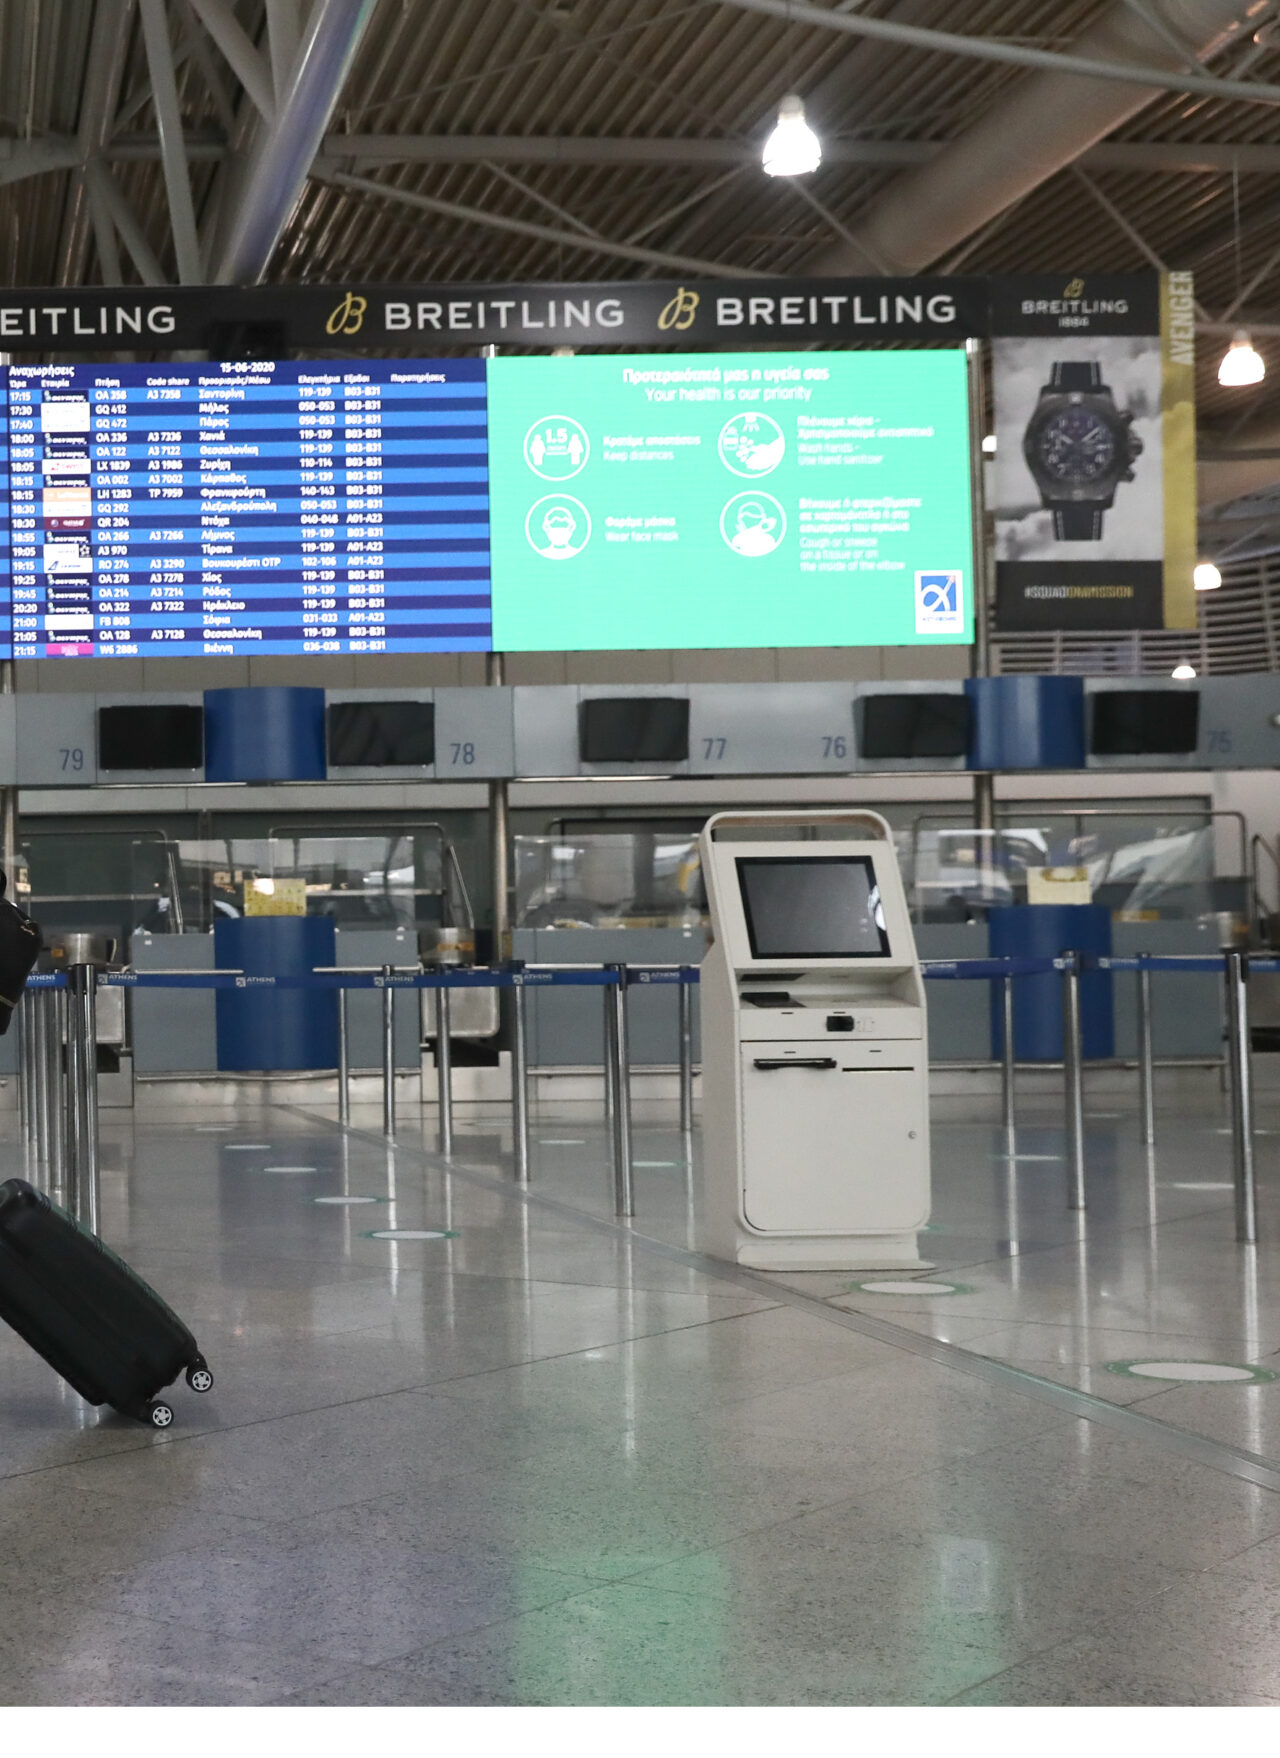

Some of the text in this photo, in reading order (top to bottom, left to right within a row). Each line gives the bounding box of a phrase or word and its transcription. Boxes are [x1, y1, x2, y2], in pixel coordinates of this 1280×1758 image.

[384, 299, 624, 330] BREITLING
[717, 295, 956, 326] BREITLING
[1021, 299, 1128, 314] BREITLING
[1170, 271, 1195, 365] AVENGER
[8, 364, 74, 377] Αναχωρήσεις
[220, 362, 275, 372] 15-06-2020
[10, 392, 31, 401] 17:15
[646, 386, 812, 402] Your health is our priority
[546, 428, 568, 443] 1.5
[450, 742, 475, 765] 78
[703, 738, 727, 760] 77
[821, 736, 846, 758] 76
[59, 748, 84, 771] 79
